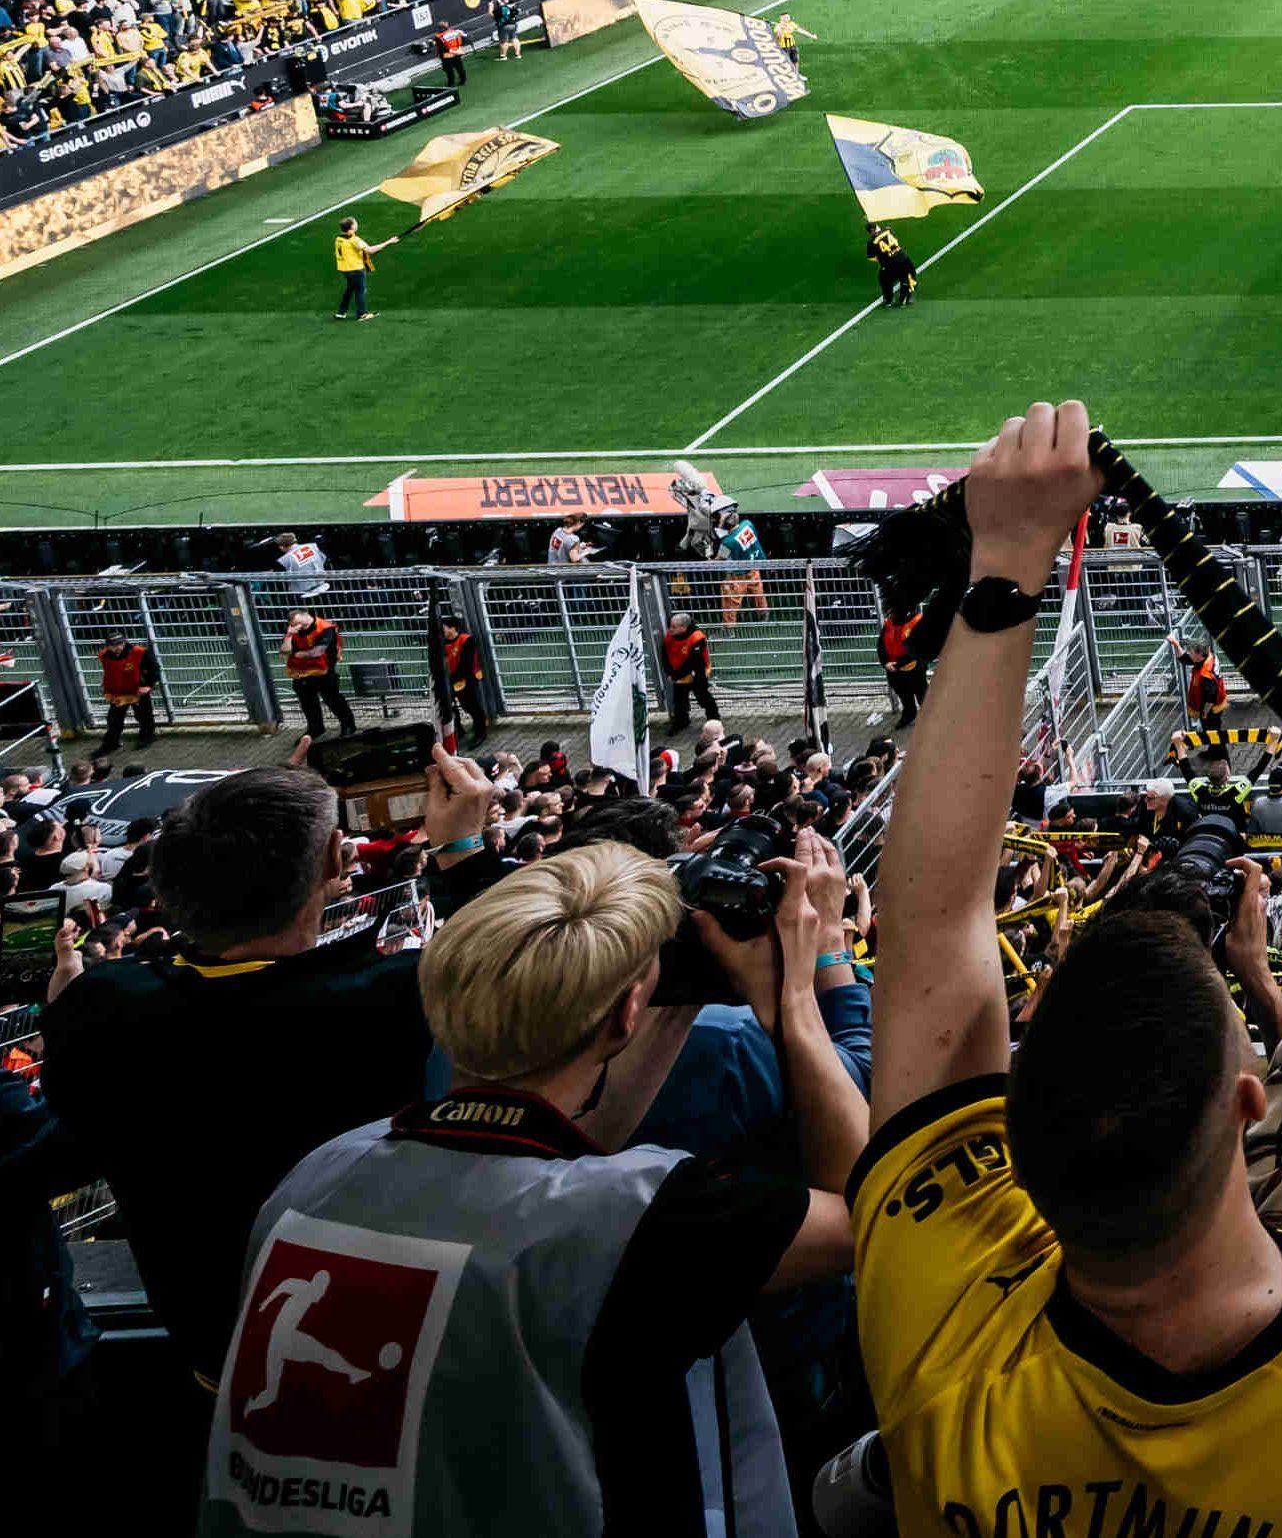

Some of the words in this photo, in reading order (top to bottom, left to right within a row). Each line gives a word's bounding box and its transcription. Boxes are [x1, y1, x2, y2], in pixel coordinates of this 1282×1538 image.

[330, 30, 378, 55] EVONIK
[38, 140, 94, 164] SIGNAL
[94, 122, 138, 144] IDUNA
[480, 477, 583, 509] EXPERT
[586, 475, 650, 506] MEN
[430, 1099, 526, 1128] Canon
